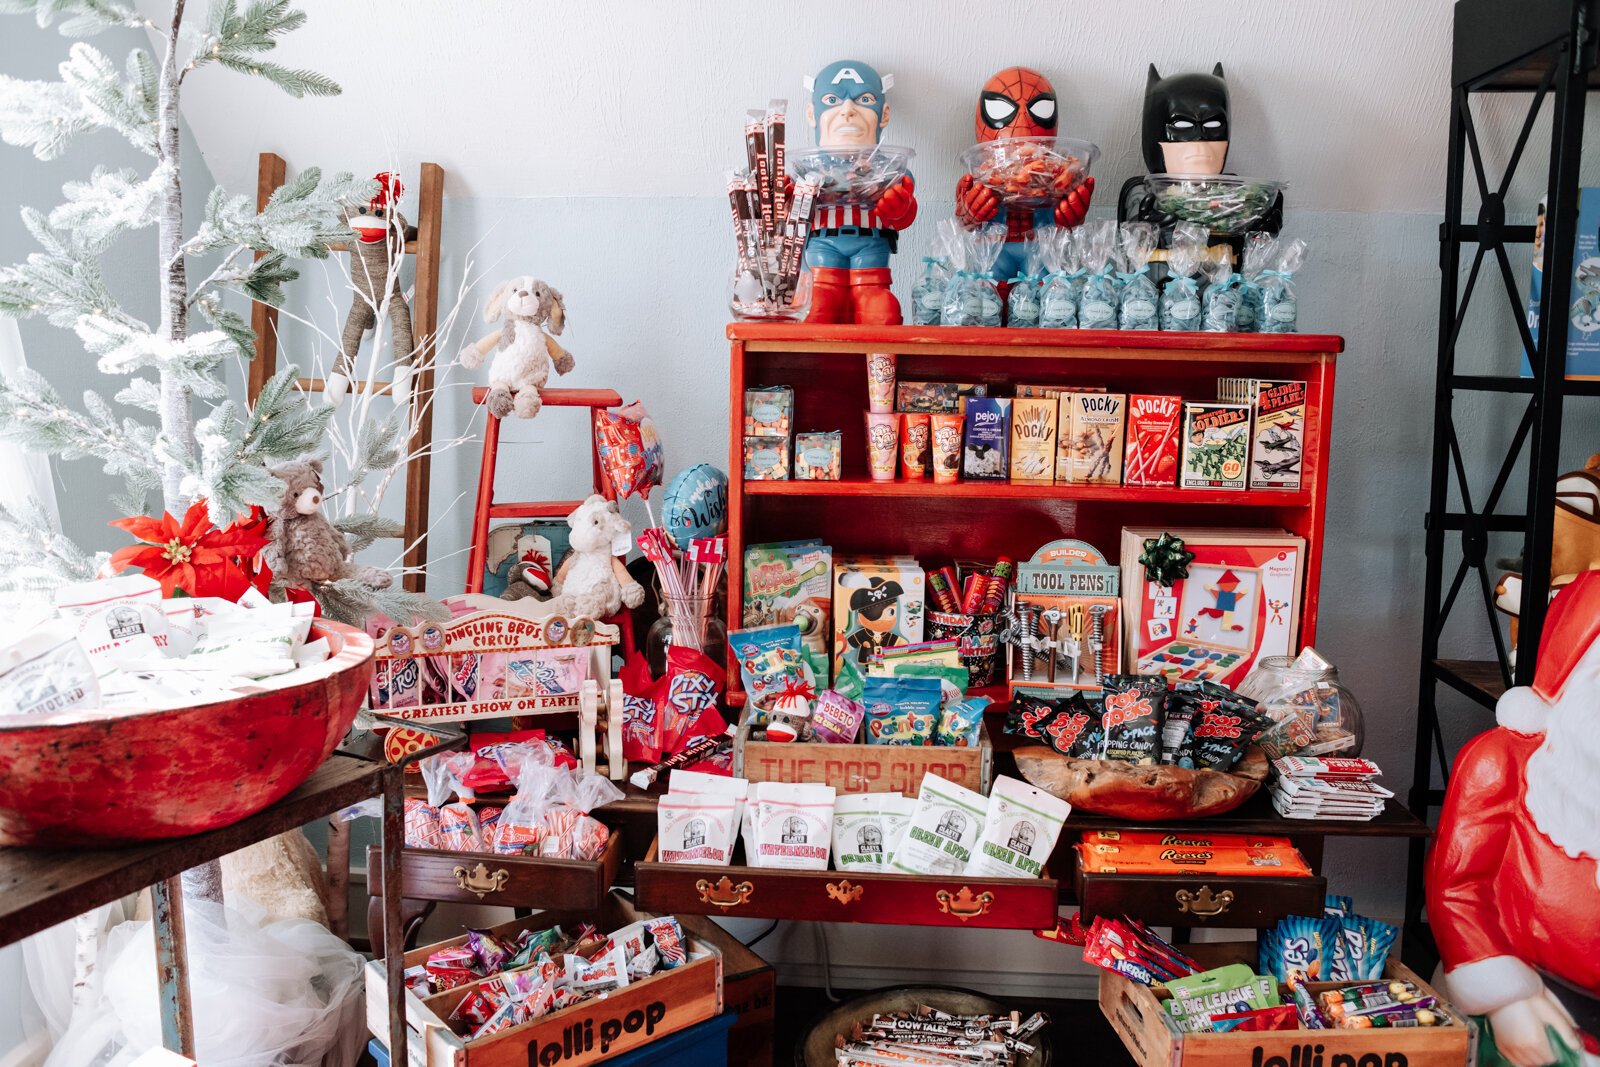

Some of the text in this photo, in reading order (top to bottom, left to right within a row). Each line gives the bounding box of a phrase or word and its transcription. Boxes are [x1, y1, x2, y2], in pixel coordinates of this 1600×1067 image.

[774, 143, 786, 219] Tootsie Roll
[757, 152, 774, 231] Tootsie Roll
[1259, 391, 1272, 411] 4
[1267, 383, 1302, 399] GLIDER
[1271, 390, 1305, 408] PLANES
[975, 411, 1000, 424] pejoy
[1192, 409, 1246, 433] SOLDIERS
[1223, 462, 1240, 472] 60
[1032, 573, 1104, 591] TOOL PENS
[507, 621, 543, 642] BROS.
[473, 635, 520, 648] CIRCUS
[1105, 688, 1141, 712] POP
[401, 704, 466, 720] GREATEST
[471, 701, 512, 714] SHOW
[517, 699, 536, 711] ON
[823, 701, 855, 727] BEBETO
[1102, 698, 1153, 730] ROCKS
[869, 710, 936, 738] Painter
[1203, 713, 1242, 727] POP
[1122, 725, 1157, 740] 3-PACK
[1193, 724, 1244, 739] ROCKS
[665, 738, 717, 768] Tootsie Roll
[1097, 740, 1154, 751] POPPING CANDY
[1200, 742, 1232, 754] 3-PACK
[1201, 750, 1223, 765] CANDY
[759, 758, 967, 794] THE POP SHOP
[909, 825, 944, 849] GREEN
[1161, 835, 1212, 847] Reese's
[661, 846, 725, 862] WATERMELON
[760, 843, 827, 861] WATERMELON
[982, 840, 1016, 865] GREEN
[1160, 849, 1213, 861] Reese's
[1181, 984, 1257, 1015] BIG LEAGUE
[528, 1000, 667, 1067] lolli pop
[898, 1019, 948, 1034] COW TALES
[876, 1049, 911, 1061] COW
